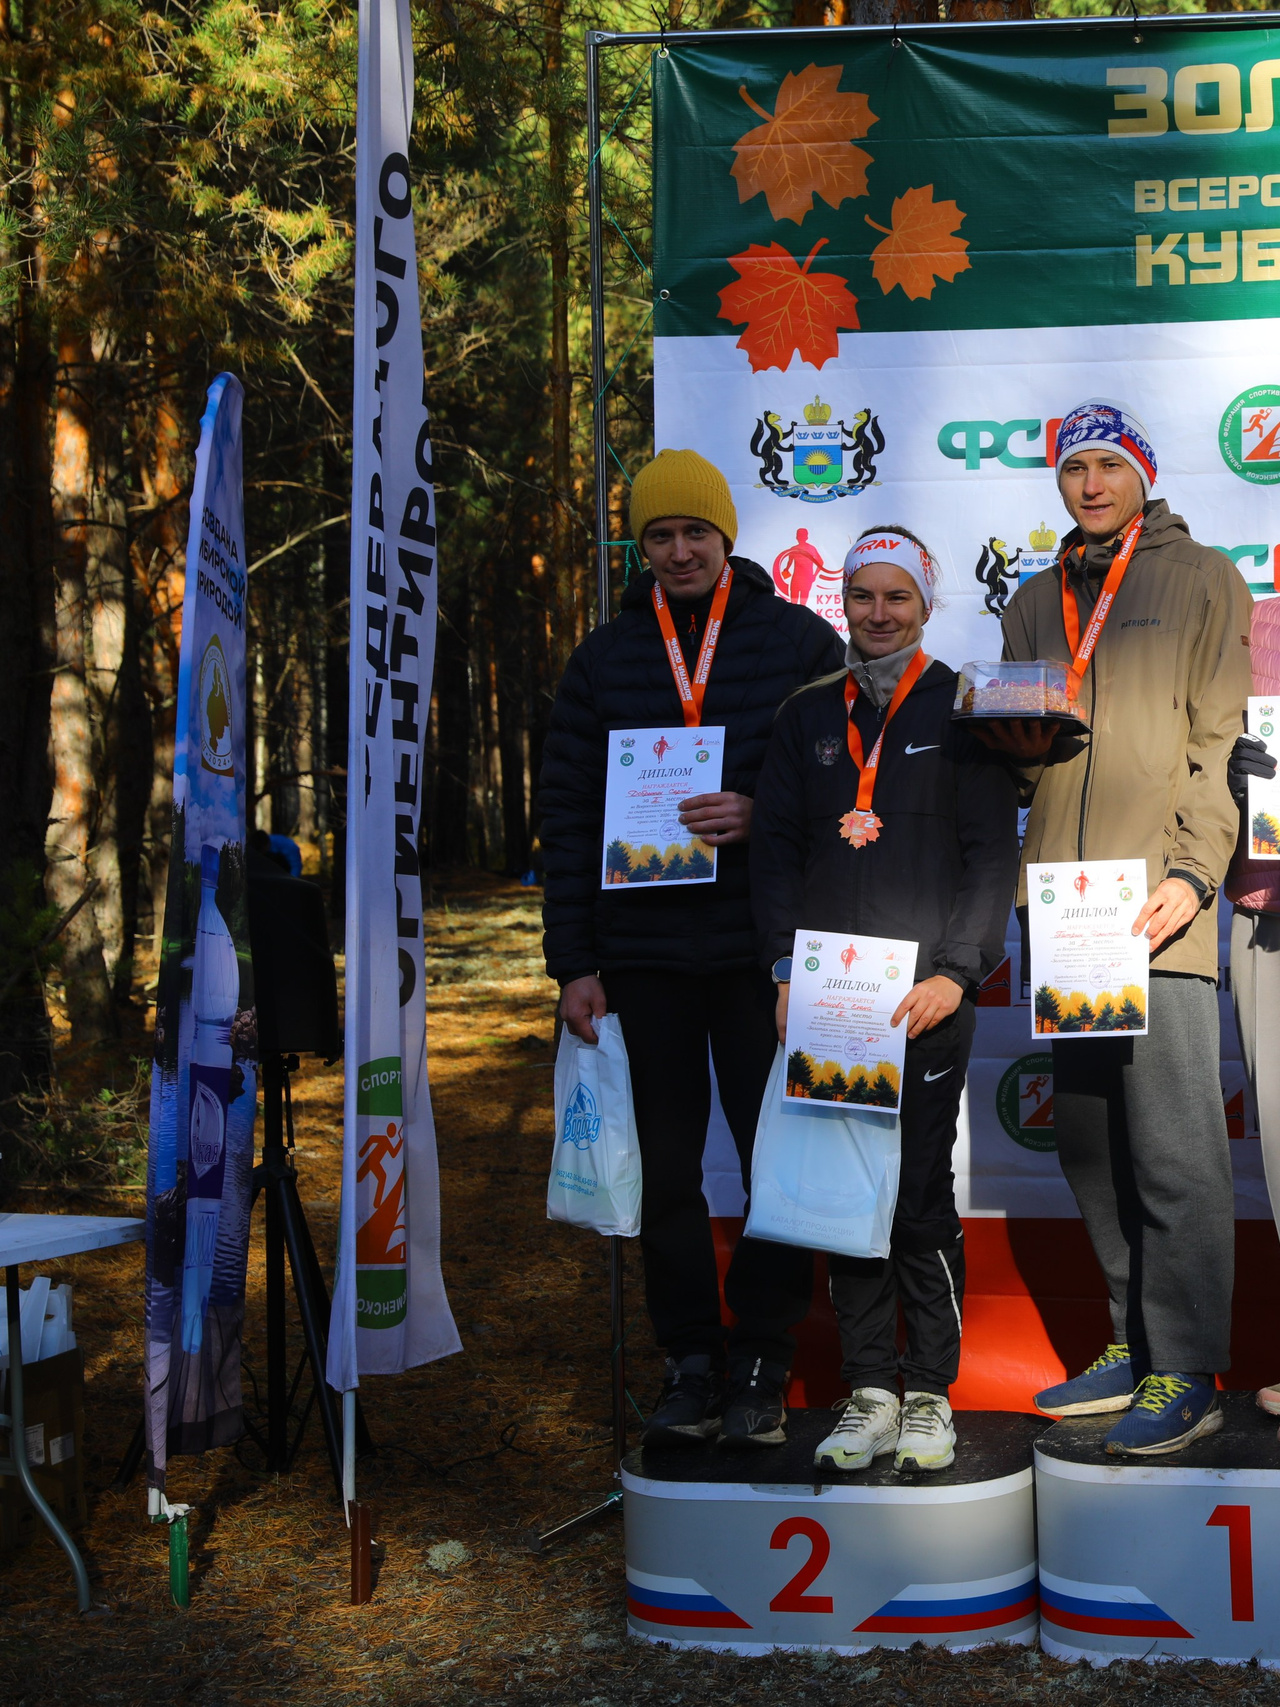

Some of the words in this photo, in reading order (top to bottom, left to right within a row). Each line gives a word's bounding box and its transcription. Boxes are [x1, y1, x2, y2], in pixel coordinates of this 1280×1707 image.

[1119, 528, 1138, 560] ТЮМЕНЬ
[816, 594, 842, 605] КУБ
[1081, 622, 1102, 661] ЗОЛОТАЯ
[1098, 593, 1113, 621] ОСЕНЬ
[1121, 619, 1149, 629] PATRIOT
[670, 637, 683, 664] ОСЕНЬ
[699, 648, 714, 685] ЗОЛОТАЯ
[708, 620, 721, 646] ОСЕНЬ
[637, 767, 693, 780] ДИПЛОМ
[642, 782, 688, 790] НАГРАЖДАЕТСЯ
[864, 817, 875, 828] 2
[1061, 907, 1118, 920] ДИПЛОМ
[822, 978, 882, 993] ДИПЛОМ
[826, 994, 876, 1005] НАГРАЖДАЕТСЯ
[1024, 1136, 1056, 1148] МЕНСКОЙ
[768, 1516, 833, 1615] 2
[1205, 1504, 1256, 1622] 1
